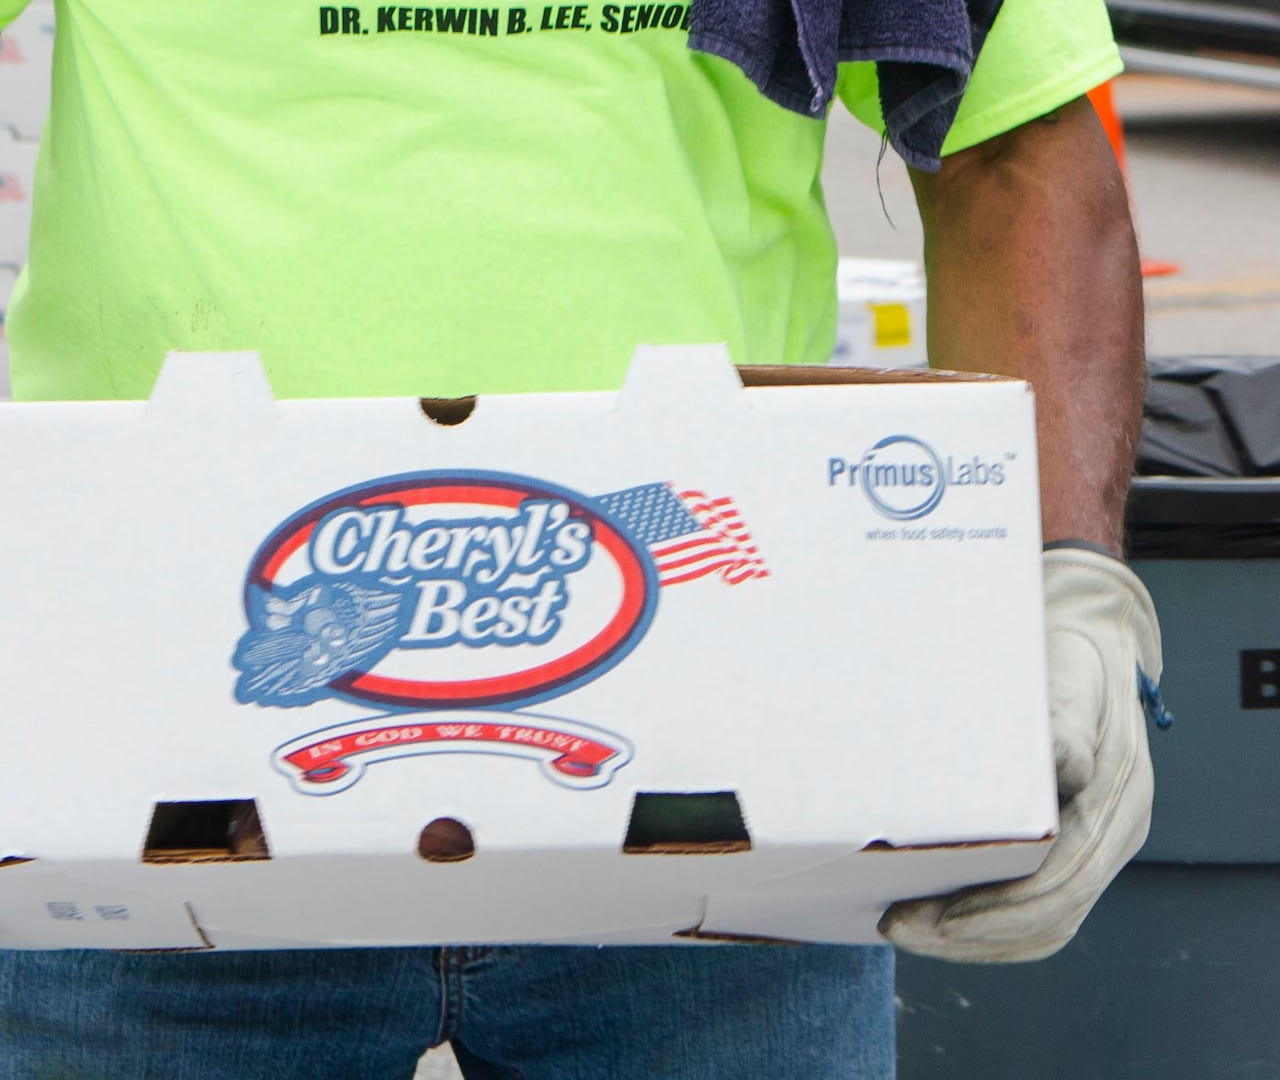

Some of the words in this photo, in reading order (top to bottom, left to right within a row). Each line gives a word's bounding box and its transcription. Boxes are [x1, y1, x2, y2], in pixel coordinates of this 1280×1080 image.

[319, 5, 369, 36] DR.
[376, 6, 500, 37] KERWIN
[506, 7, 533, 35] B.
[540, 4, 592, 32] LEE,
[312, 502, 592, 585] Cheryl's
[399, 579, 564, 642] Best
[308, 738, 344, 761] IN
[354, 725, 424, 747] GOD
[435, 723, 484, 738] WE
[495, 724, 590, 753] TRUST
